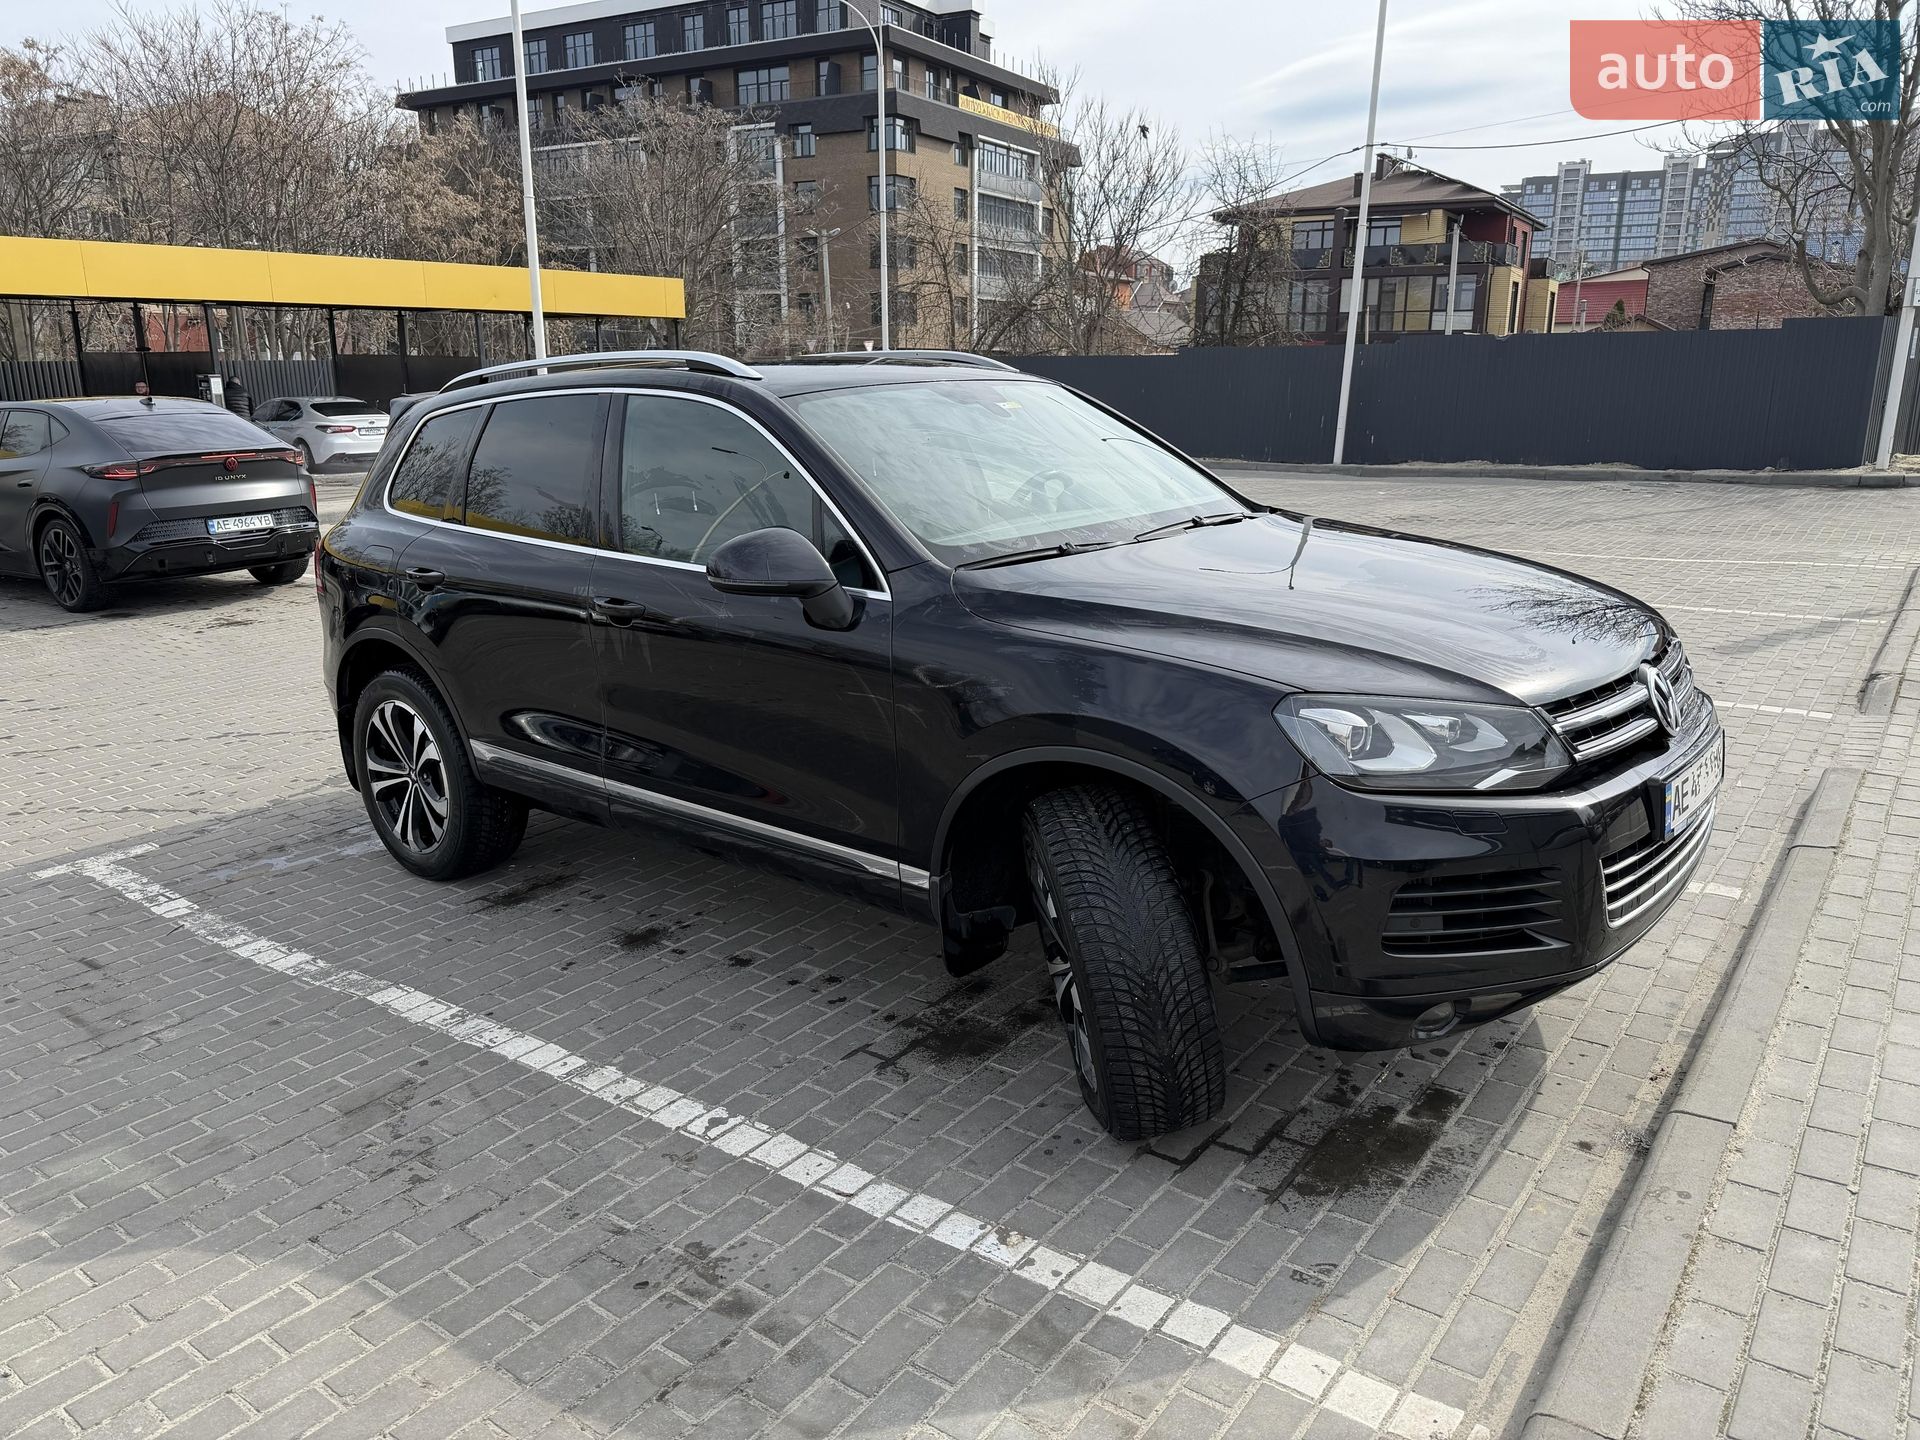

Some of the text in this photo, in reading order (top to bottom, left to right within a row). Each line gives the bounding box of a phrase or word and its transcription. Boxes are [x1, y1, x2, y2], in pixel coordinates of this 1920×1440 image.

[216, 520, 231, 532] AE
[233, 516, 256, 530] 4964
[1673, 776, 1689, 821] AE
